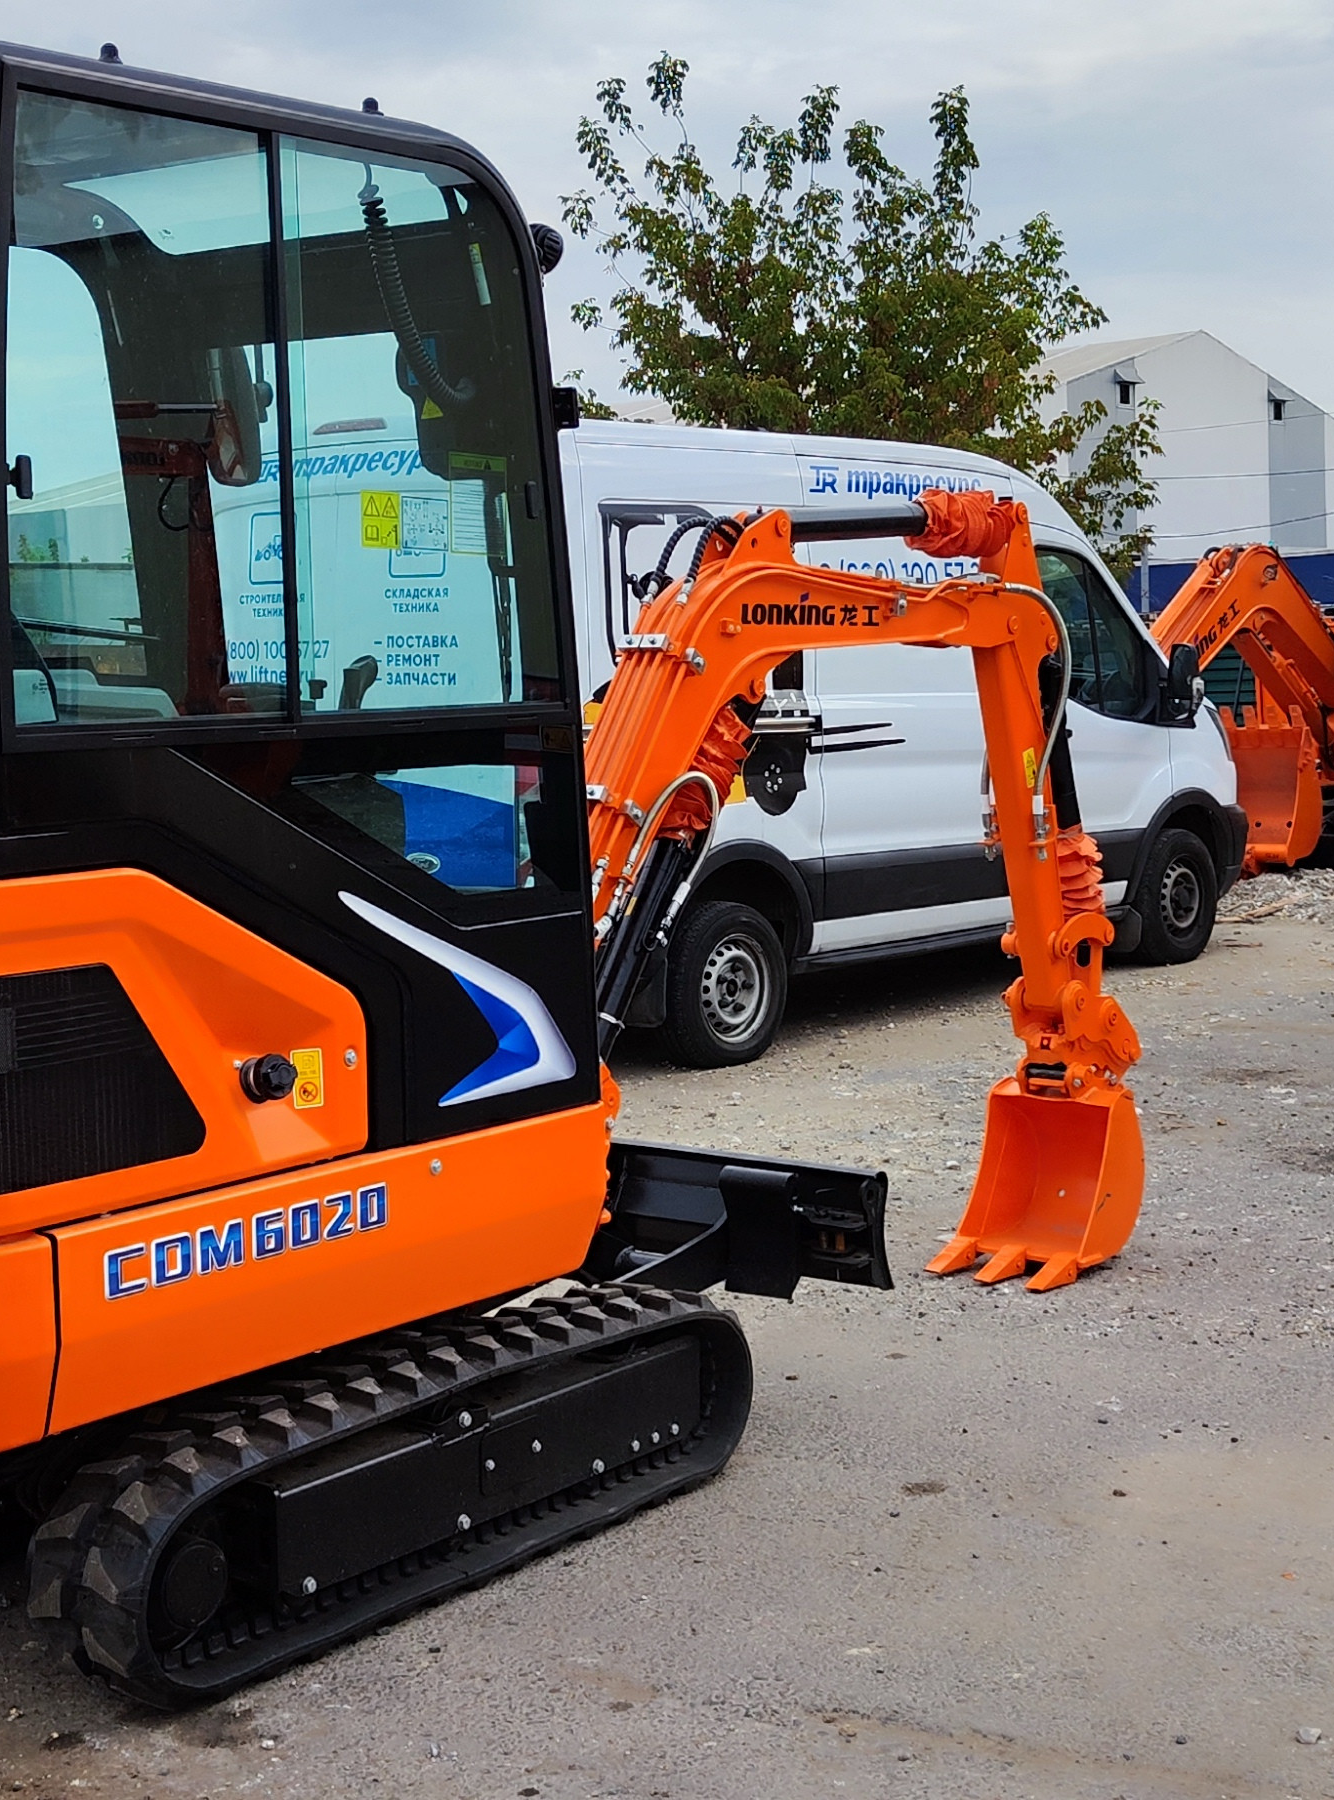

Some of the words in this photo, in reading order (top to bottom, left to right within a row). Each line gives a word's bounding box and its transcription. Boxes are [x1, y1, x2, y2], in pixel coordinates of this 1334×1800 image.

[384, 587, 450, 600] СКЛАДСКАЯ
[252, 608, 284, 618] ТЕХНИК
[392, 602, 440, 613] ТЕХНИКА
[839, 604, 880, 627] 龙工
[386, 635, 459, 649] ПОСТАВКА
[312, 640, 330, 659] 27
[386, 653, 440, 667] РЕМОНТ
[386, 672, 457, 686] ЗАПЧАСТИ
[103, 1181, 388, 1301] CDM6020
